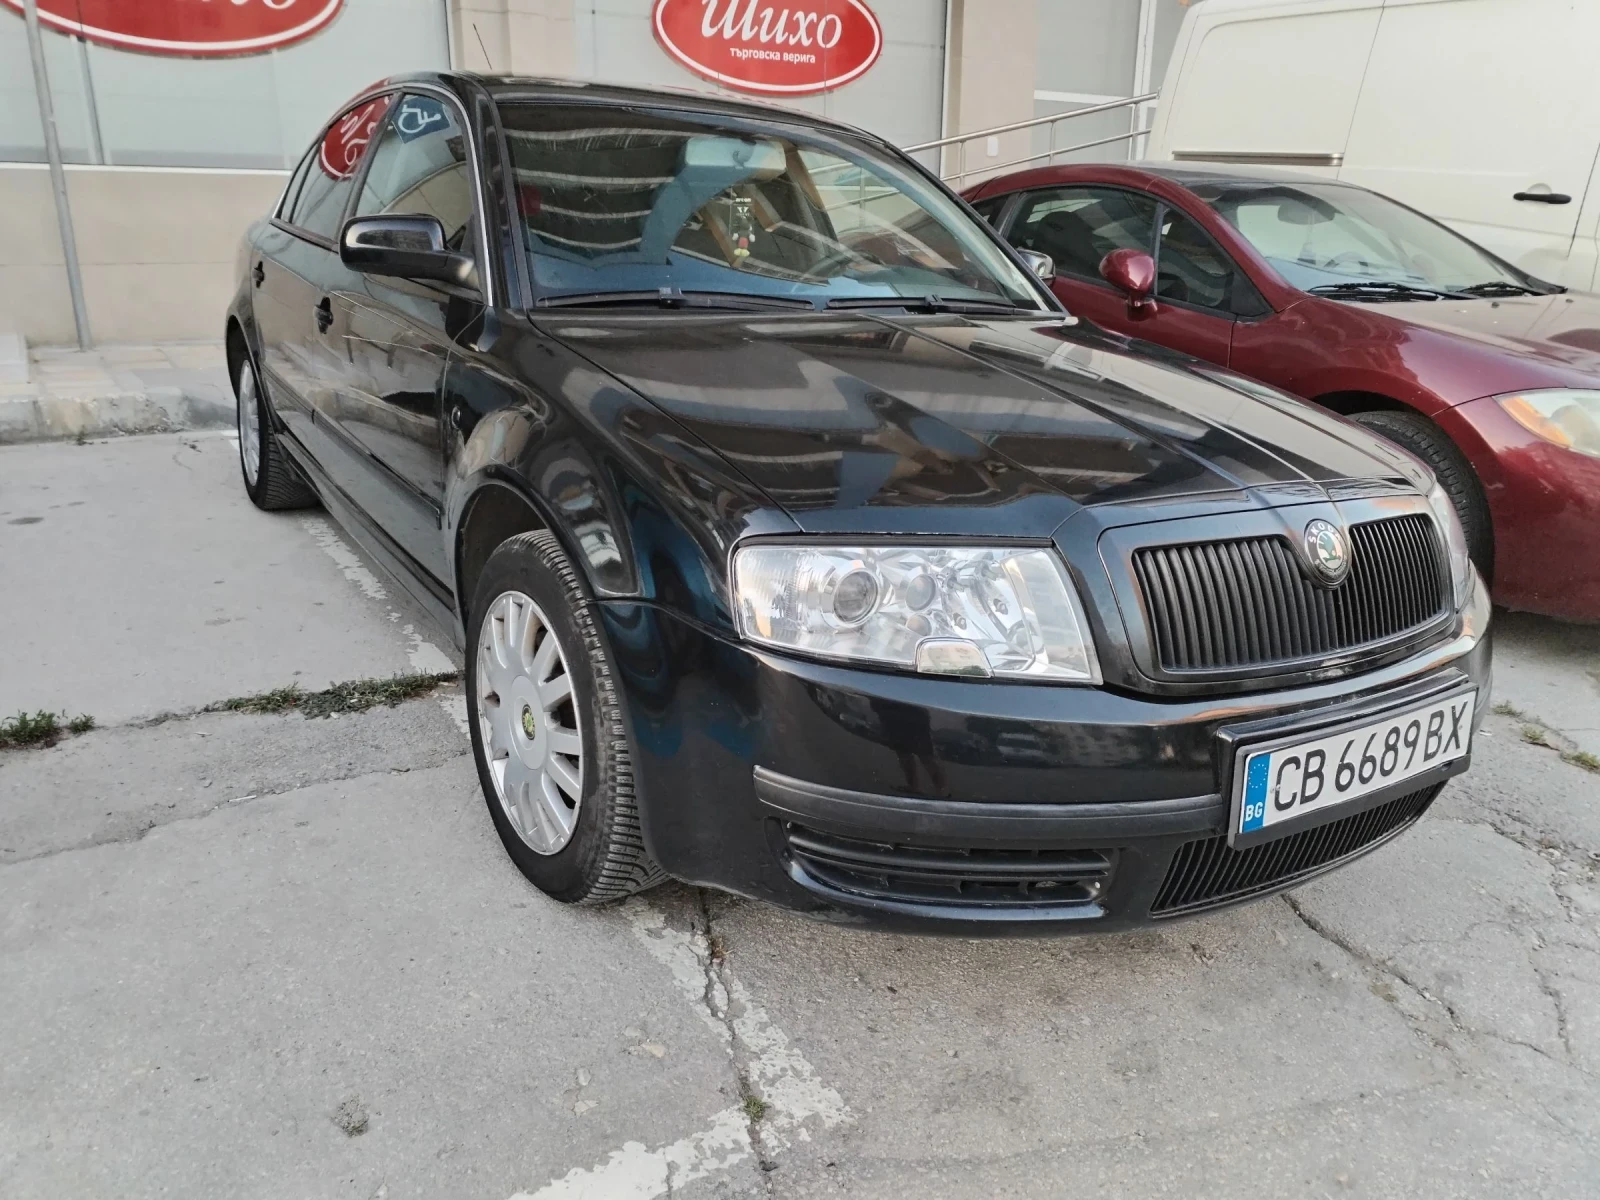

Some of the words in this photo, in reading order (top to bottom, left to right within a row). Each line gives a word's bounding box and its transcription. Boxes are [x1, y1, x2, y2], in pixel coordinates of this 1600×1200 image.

[730, 47, 781, 61] търговска
[783, 52, 816, 64] верига
[1334, 719, 1421, 793] 6689
[1245, 801, 1264, 822] BG
